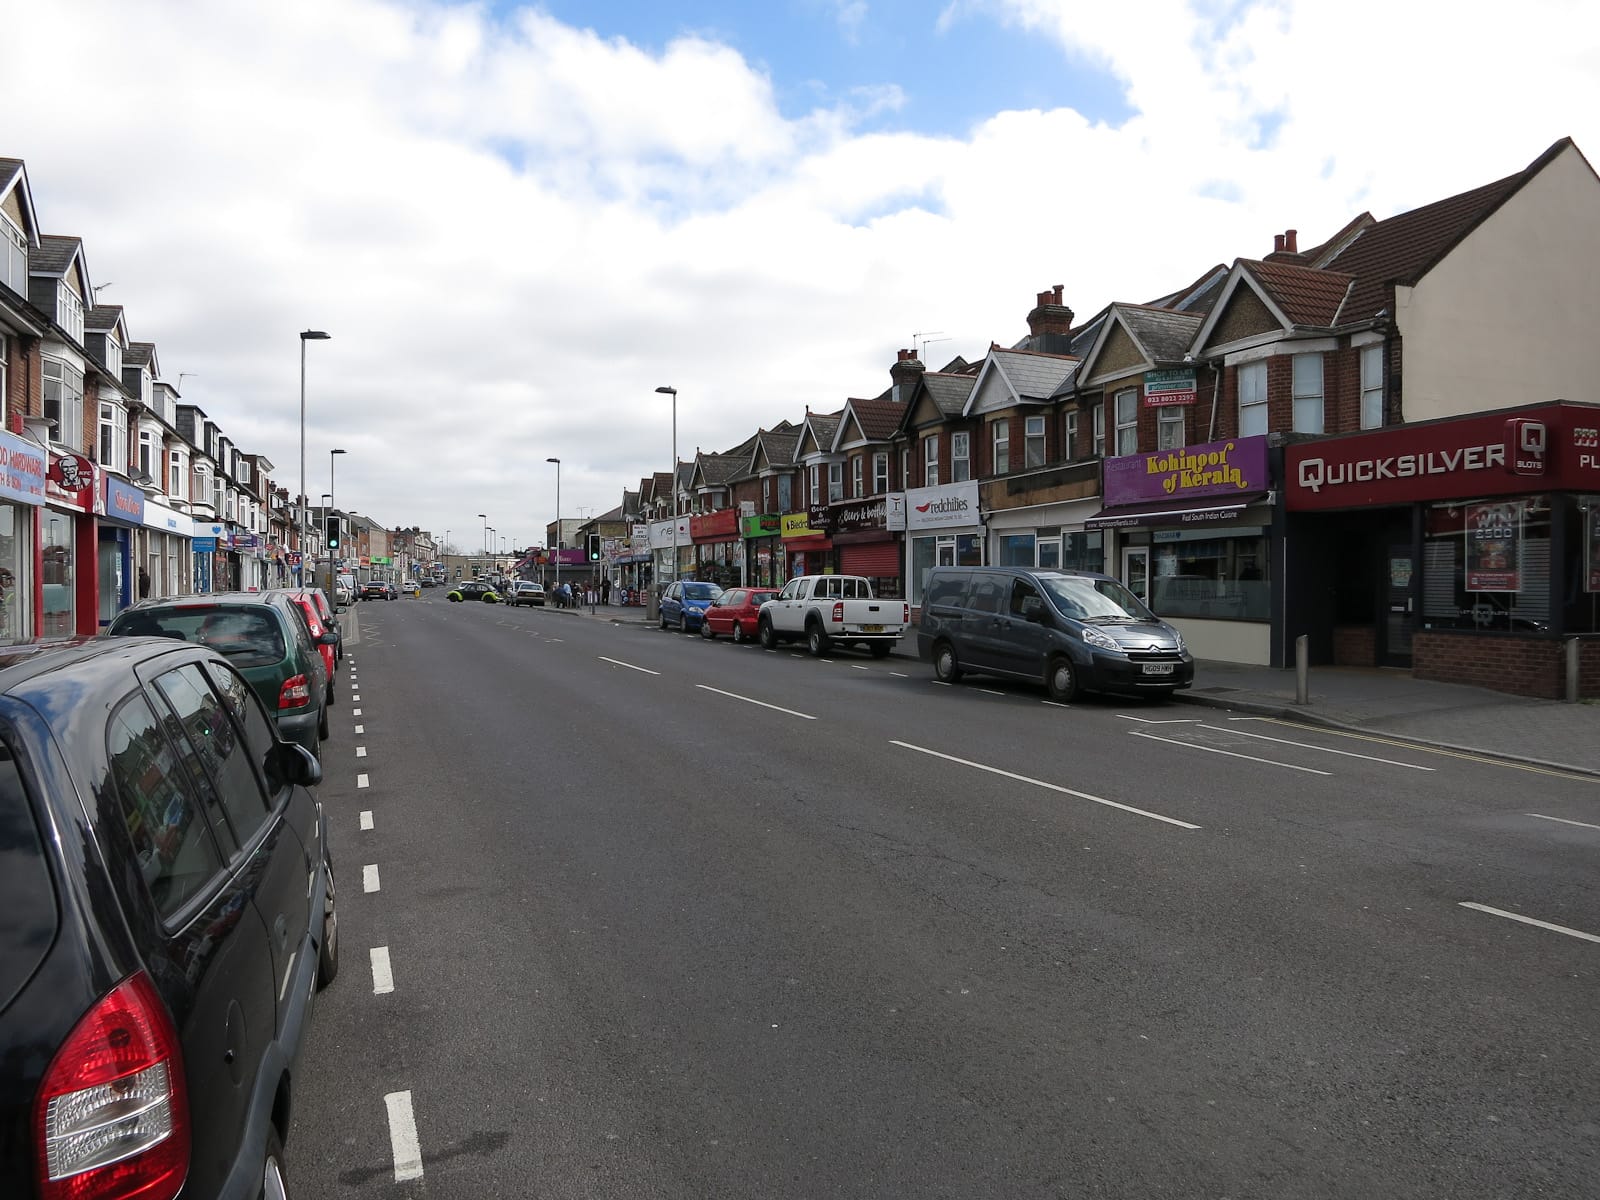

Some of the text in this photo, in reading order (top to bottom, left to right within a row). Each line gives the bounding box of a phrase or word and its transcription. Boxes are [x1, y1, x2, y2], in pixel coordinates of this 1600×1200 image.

[1146, 442, 1235, 474] Kohinoor
[1299, 443, 1505, 493] QUICKSILVER
[1517, 460, 1543, 470] SLOTS
[1162, 465, 1249, 494] of Kerala
